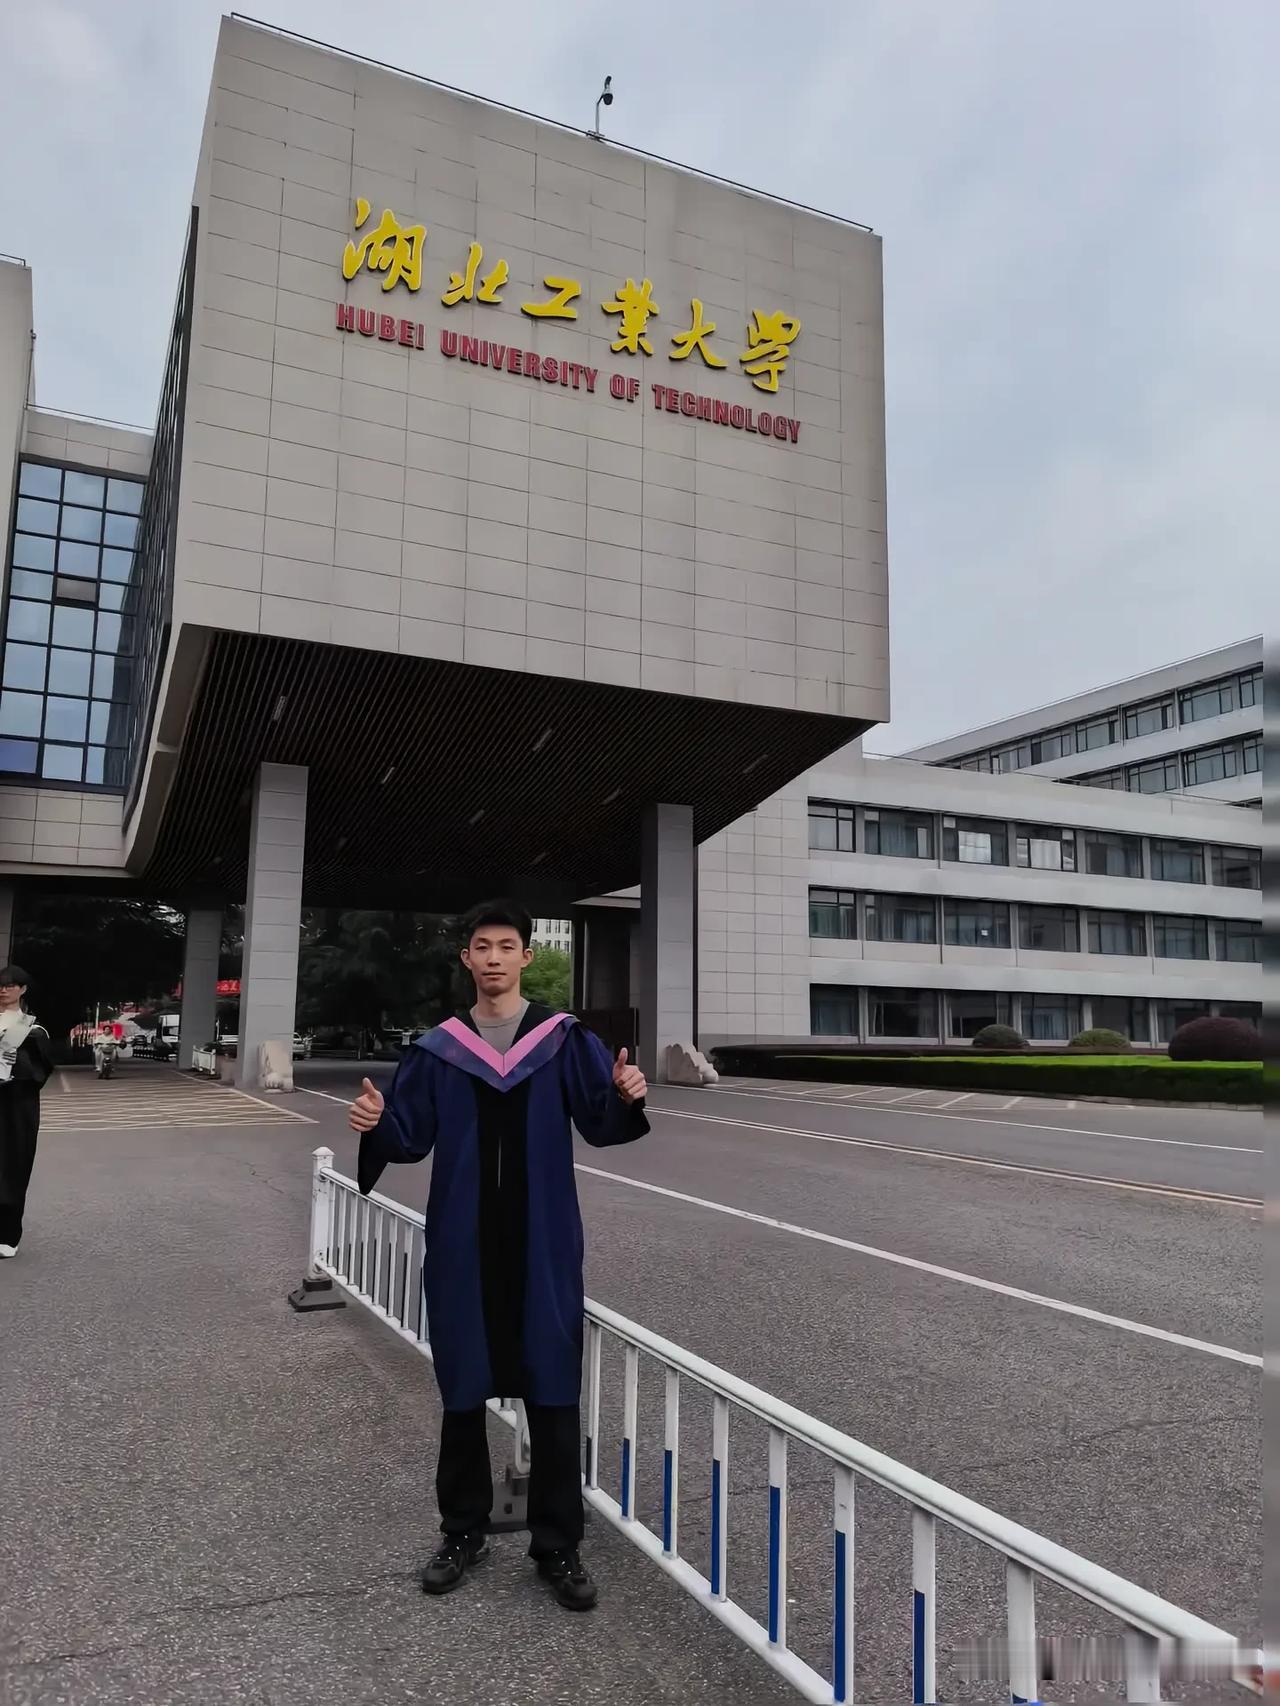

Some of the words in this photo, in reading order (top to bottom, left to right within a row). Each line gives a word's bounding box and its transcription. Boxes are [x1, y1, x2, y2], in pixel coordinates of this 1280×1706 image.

[336, 303, 425, 350] HUBEI
[440, 329, 598, 393] UNIVERSITY
[609, 373, 640, 402] OF
[652, 383, 801, 444] TECHNOLOGY
